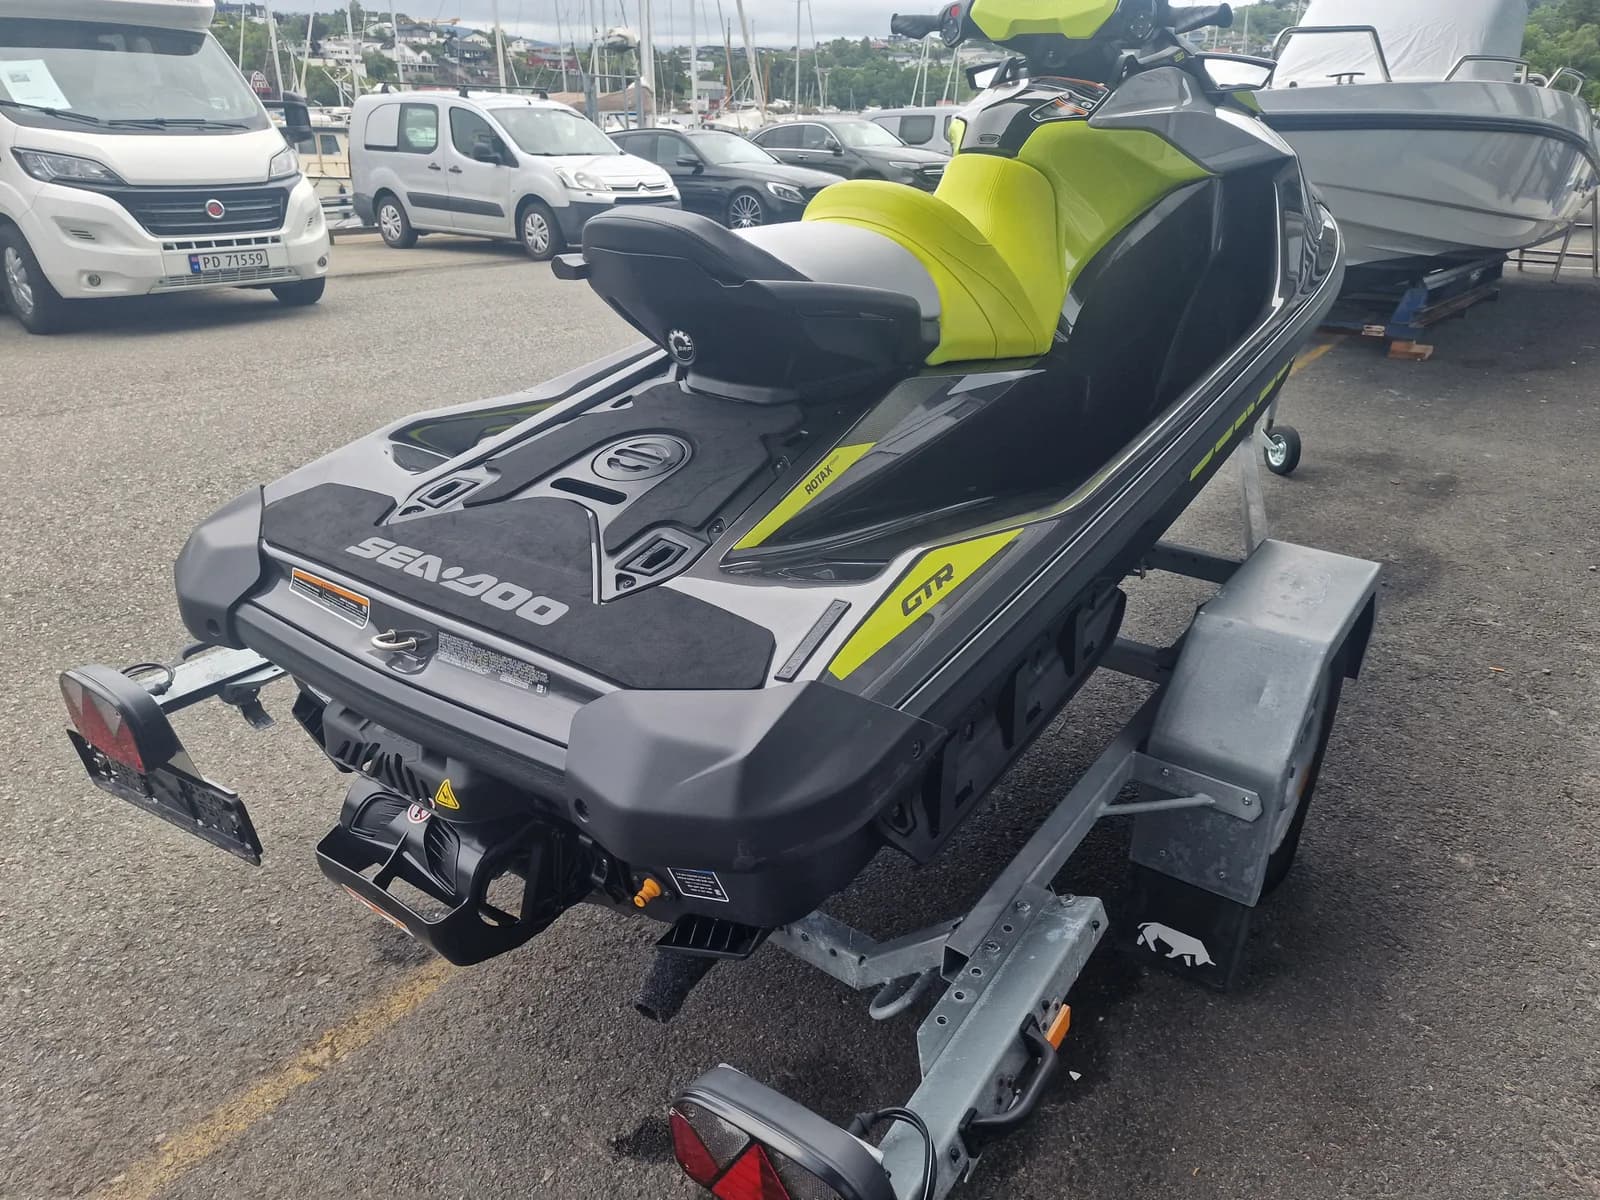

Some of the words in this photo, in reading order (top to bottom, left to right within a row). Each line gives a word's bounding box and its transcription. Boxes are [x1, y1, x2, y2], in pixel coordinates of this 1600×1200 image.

[203, 256, 220, 268] PD
[225, 253, 263, 267] 71559
[805, 465, 832, 495] ROTAX
[901, 563, 954, 617] GTR
